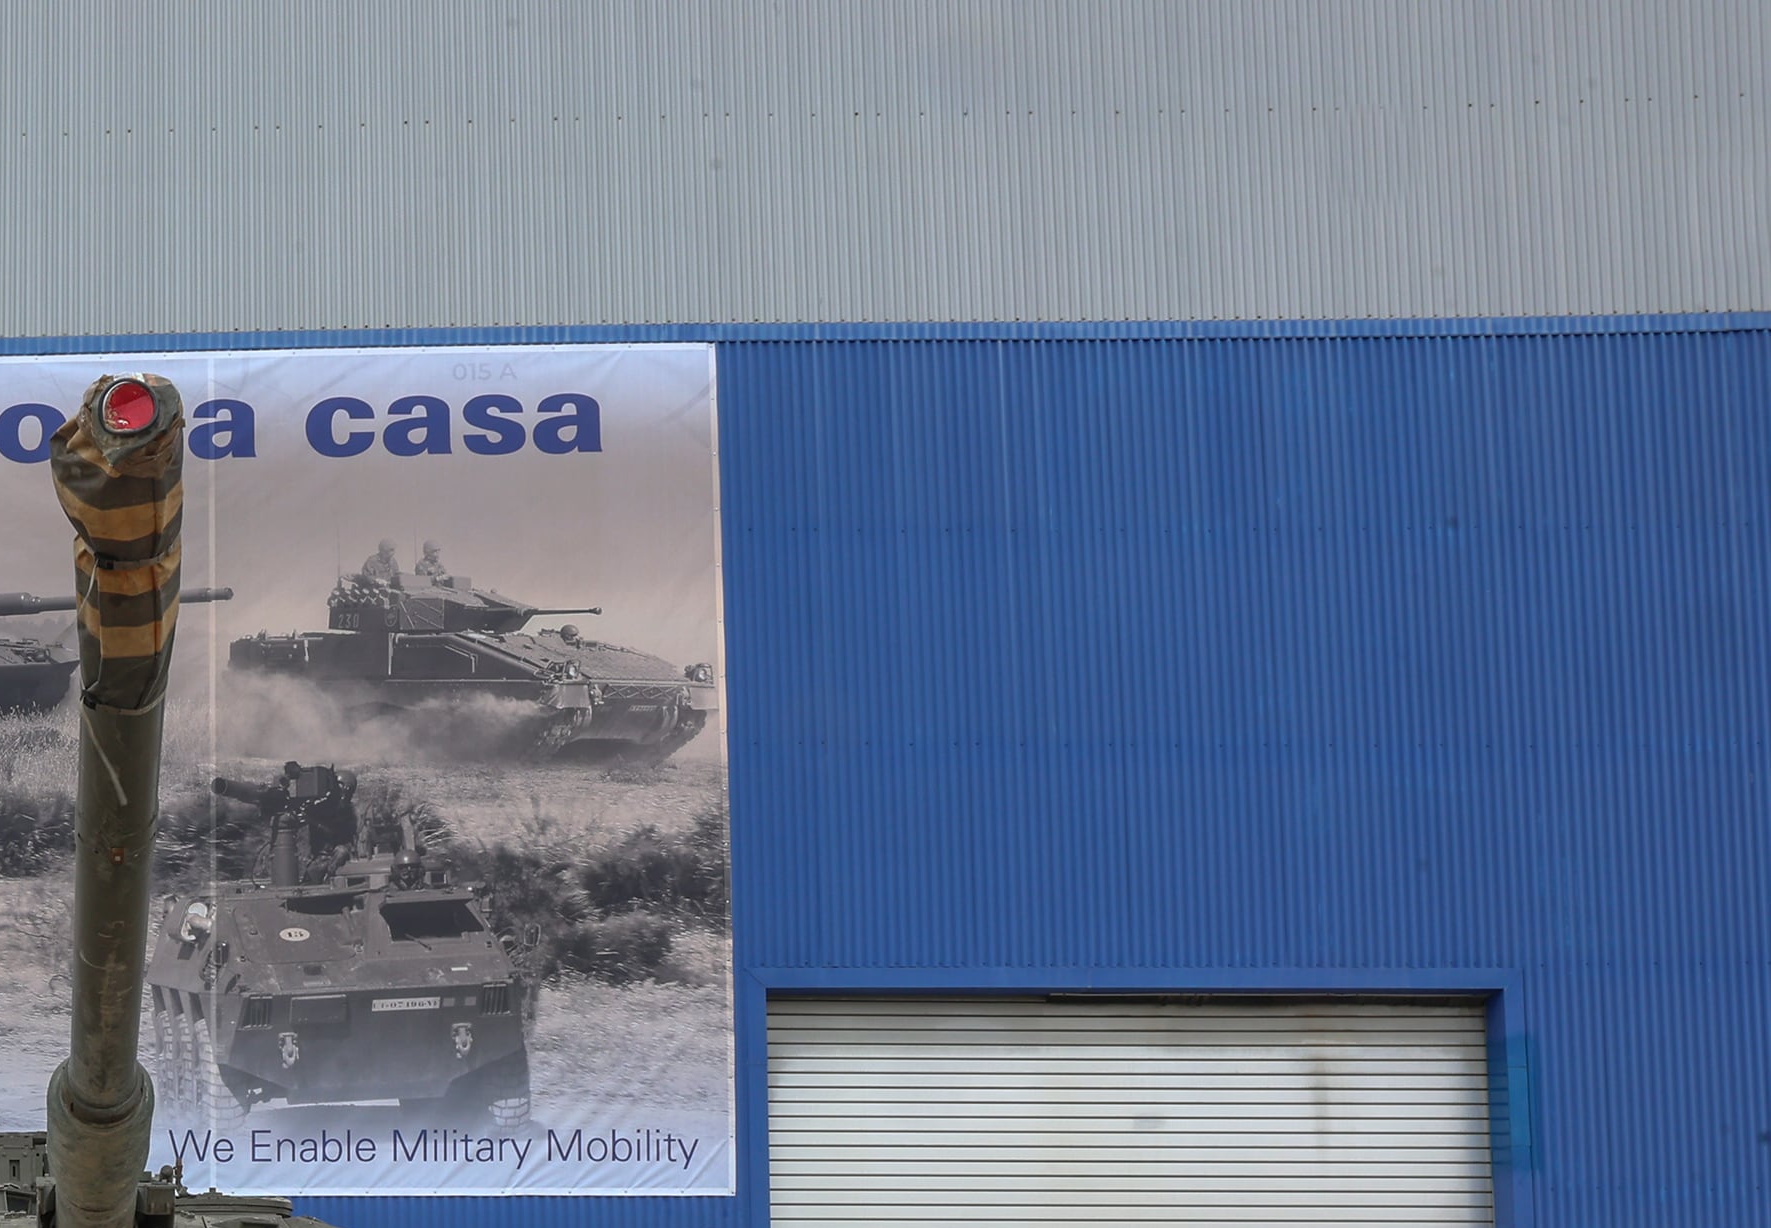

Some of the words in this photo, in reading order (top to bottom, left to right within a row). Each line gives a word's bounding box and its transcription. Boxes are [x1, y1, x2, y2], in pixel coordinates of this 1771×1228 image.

[451, 362, 493, 381] 015
[499, 362, 518, 381] A
[187, 398, 257, 460] a
[305, 393, 603, 458] casa
[168, 1128, 234, 1163] We
[250, 1127, 378, 1163] Enable
[391, 1127, 533, 1171] Military
[546, 1127, 700, 1171] Mobility
